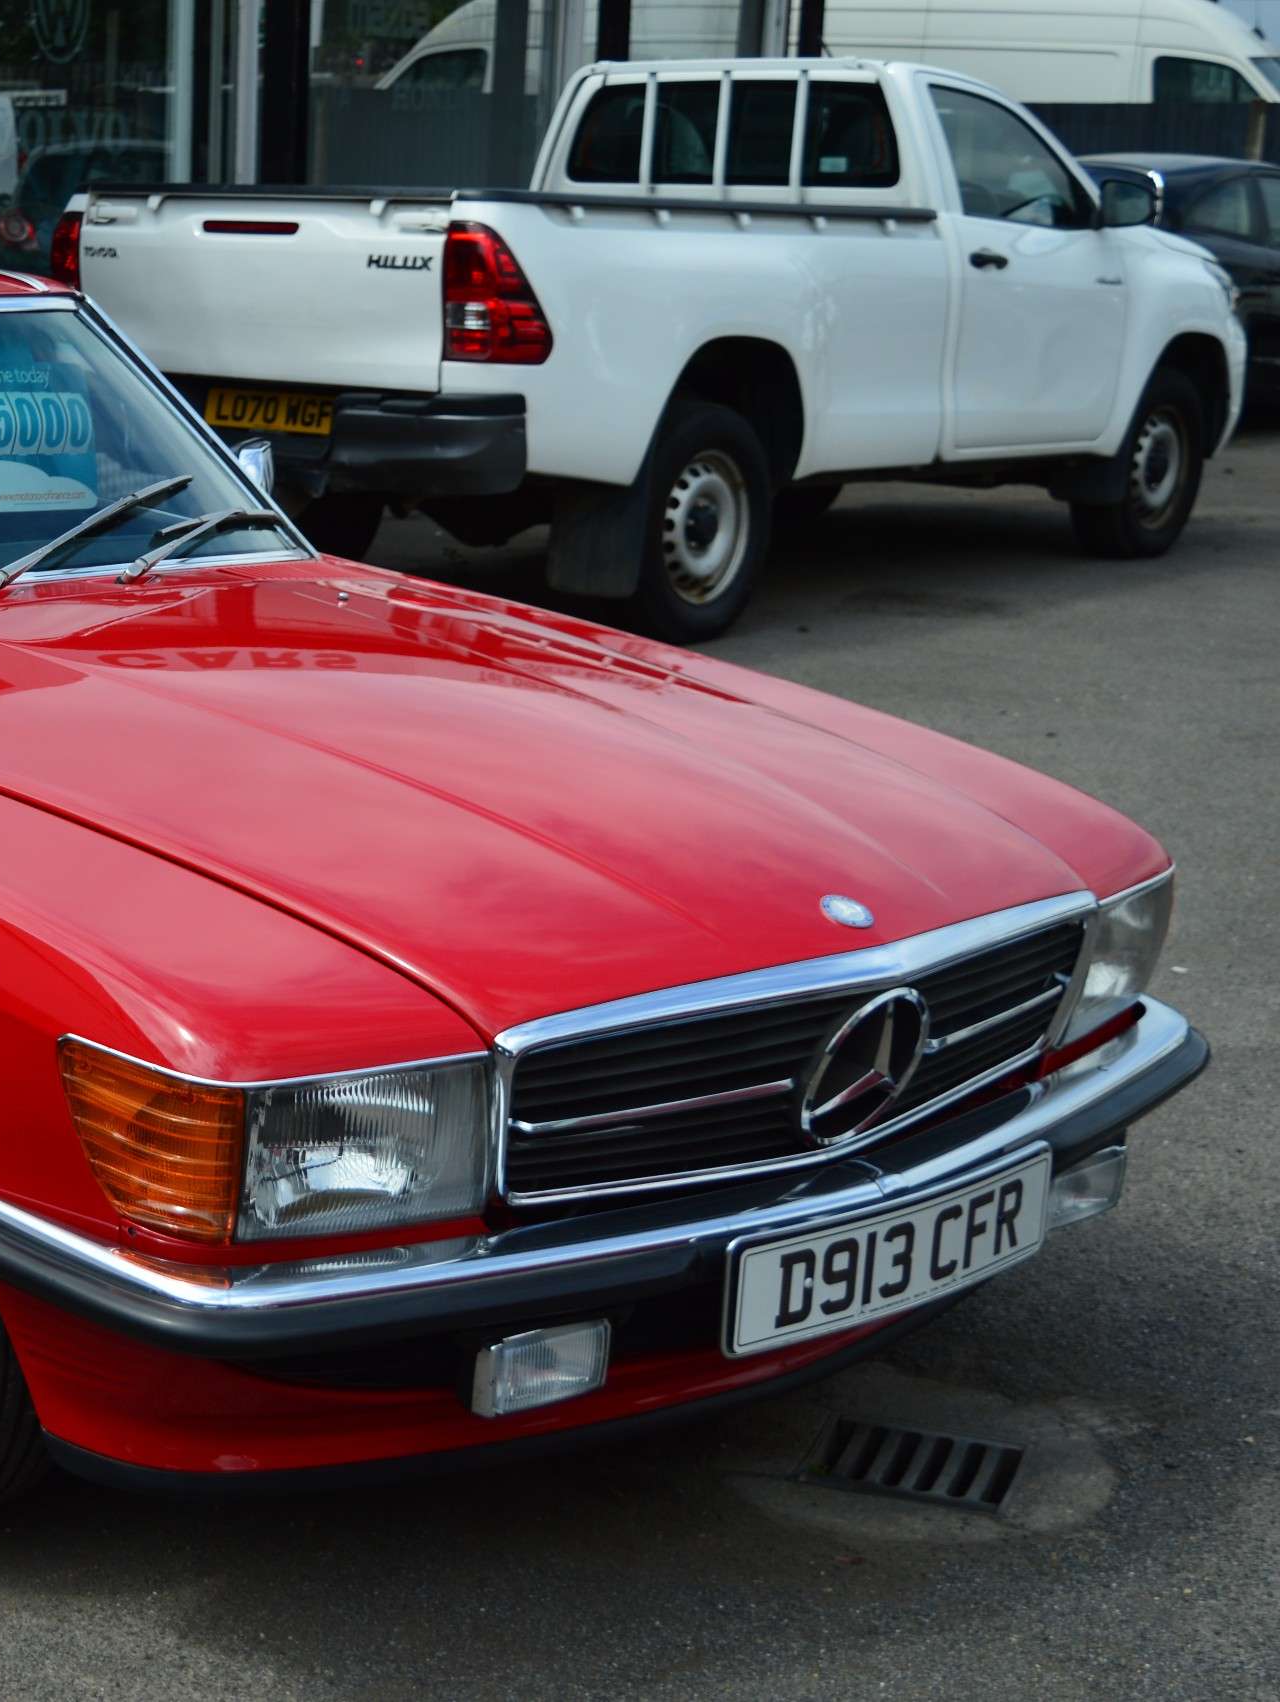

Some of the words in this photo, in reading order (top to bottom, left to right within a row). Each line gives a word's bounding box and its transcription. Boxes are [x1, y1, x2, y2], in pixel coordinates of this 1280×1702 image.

[367, 254, 433, 271] HILUX
[14, 365, 51, 389] today
[775, 1220, 915, 1329] D913
[929, 1178, 1024, 1282] CFR
